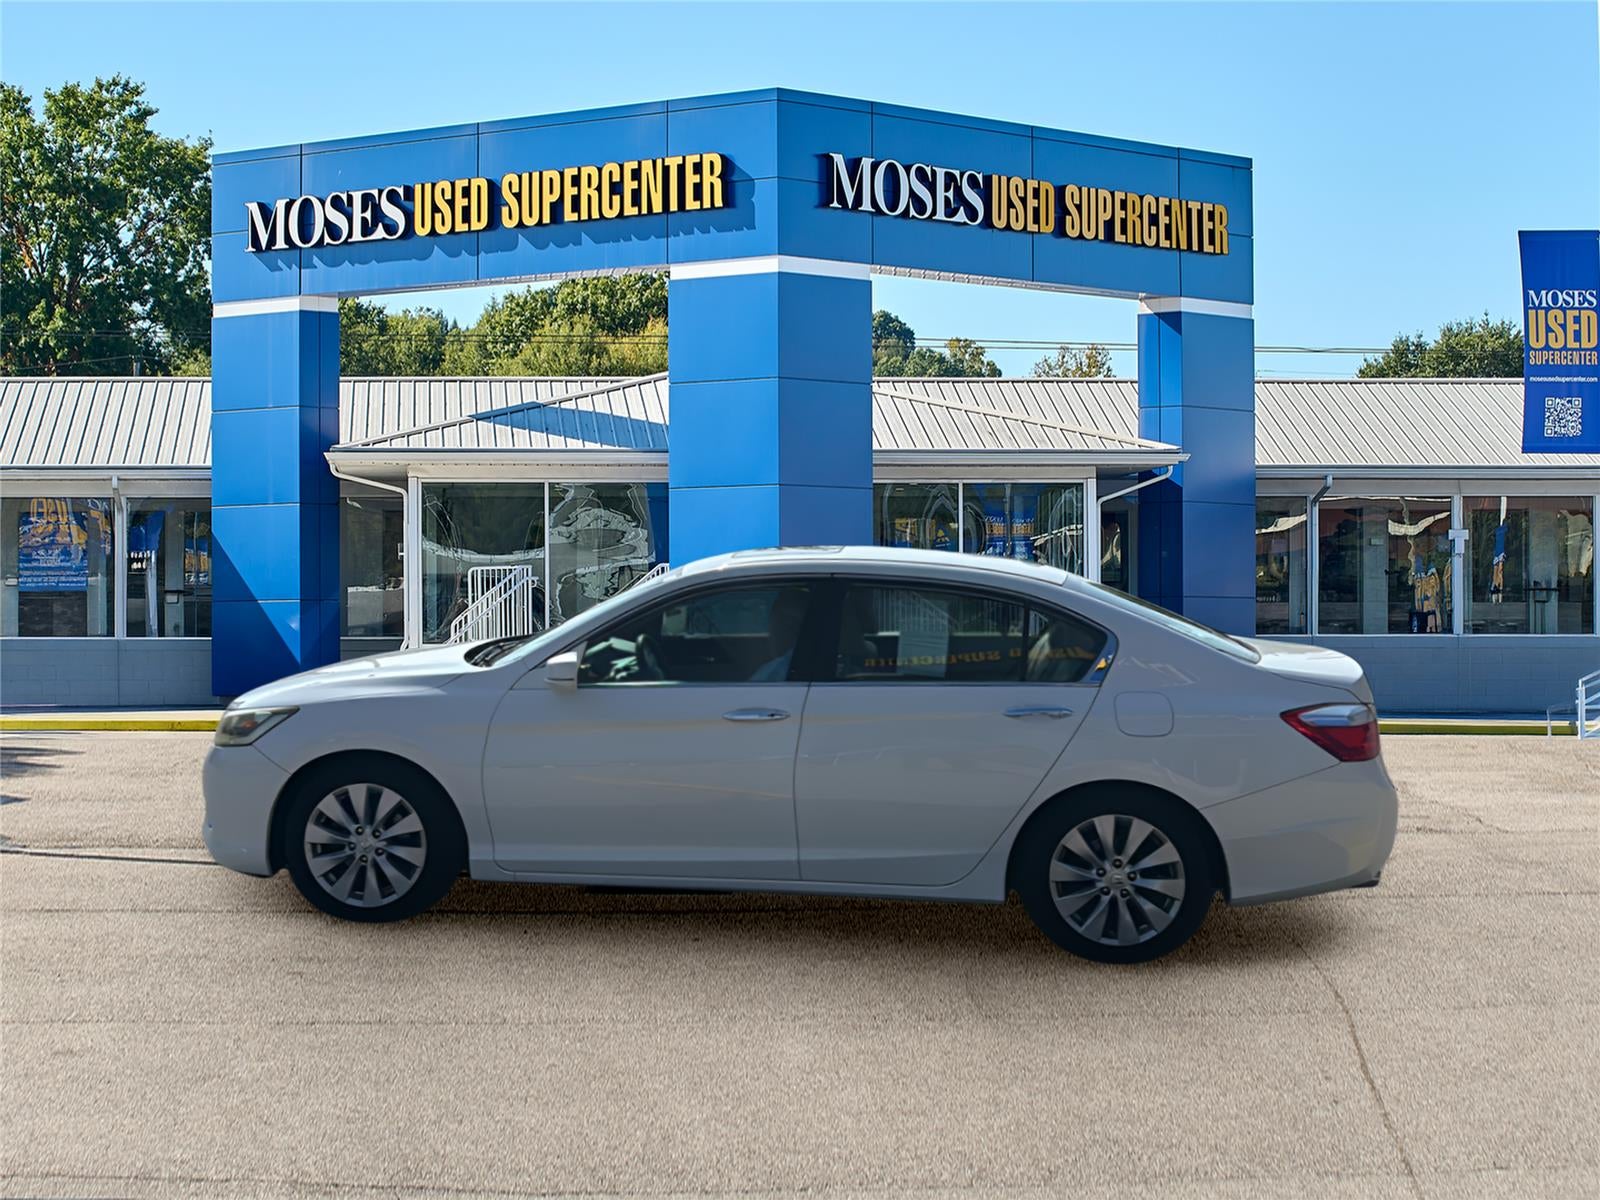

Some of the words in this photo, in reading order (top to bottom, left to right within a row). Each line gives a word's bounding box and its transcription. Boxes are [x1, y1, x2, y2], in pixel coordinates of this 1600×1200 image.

[244, 185, 406, 252] MOSES
[413, 177, 488, 237] USED
[501, 152, 724, 228] SUPERCENTER
[829, 152, 984, 225] MOSES
[991, 175, 1056, 233] USED
[1064, 184, 1229, 255] SUPERCENTER
[1528, 290, 1597, 308] MOSES
[1528, 309, 1598, 349] USED
[1529, 351, 1598, 365] SUPERCENTER
